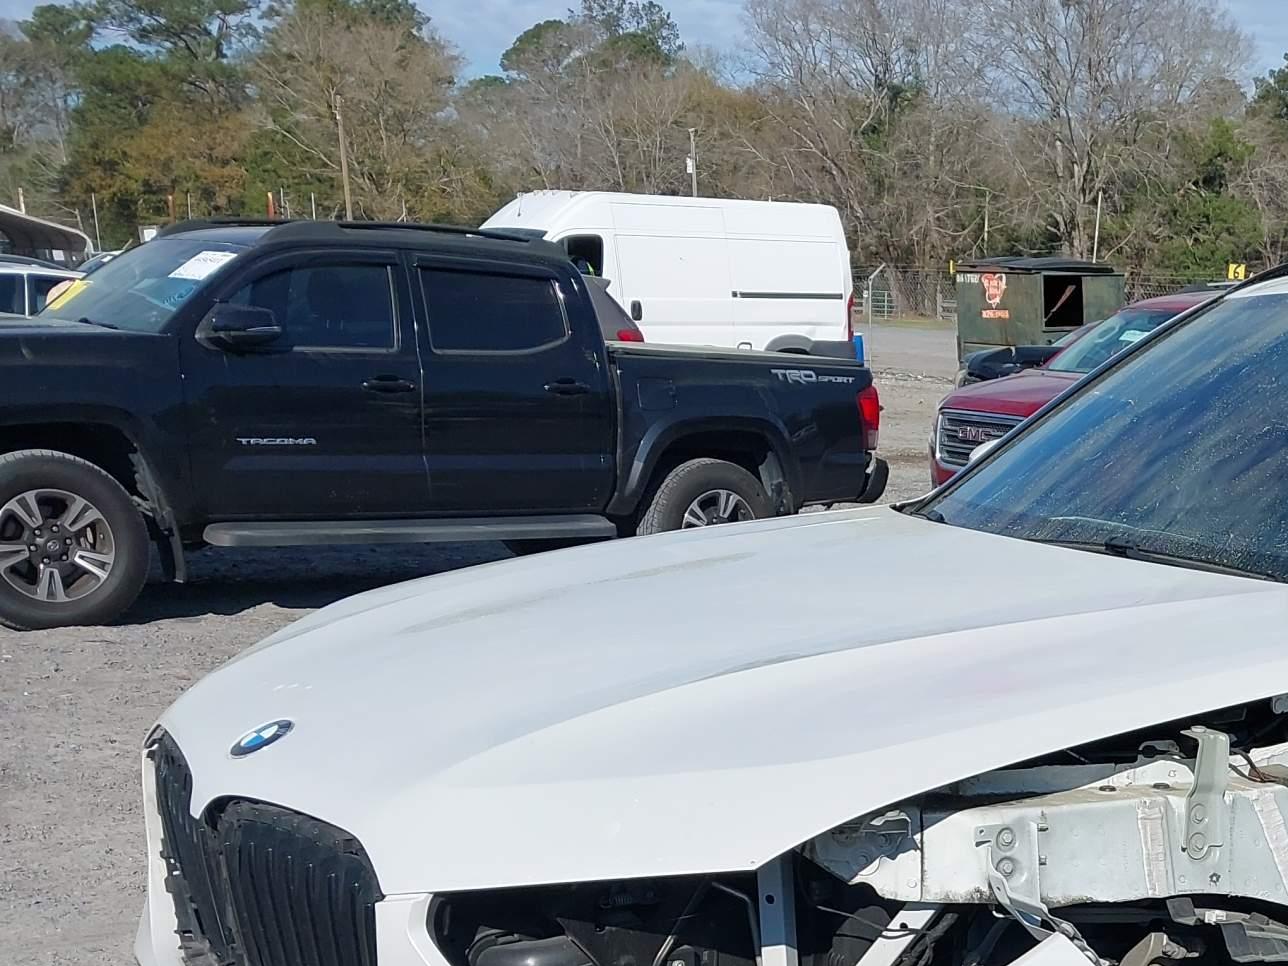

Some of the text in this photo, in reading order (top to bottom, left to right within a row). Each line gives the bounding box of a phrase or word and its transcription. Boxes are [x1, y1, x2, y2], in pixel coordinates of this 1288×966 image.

[1233, 264, 1241, 279] 6
[770, 368, 855, 384] TRD SPORT
[236, 437, 318, 445] TACOMA
[958, 426, 993, 442] GMC
